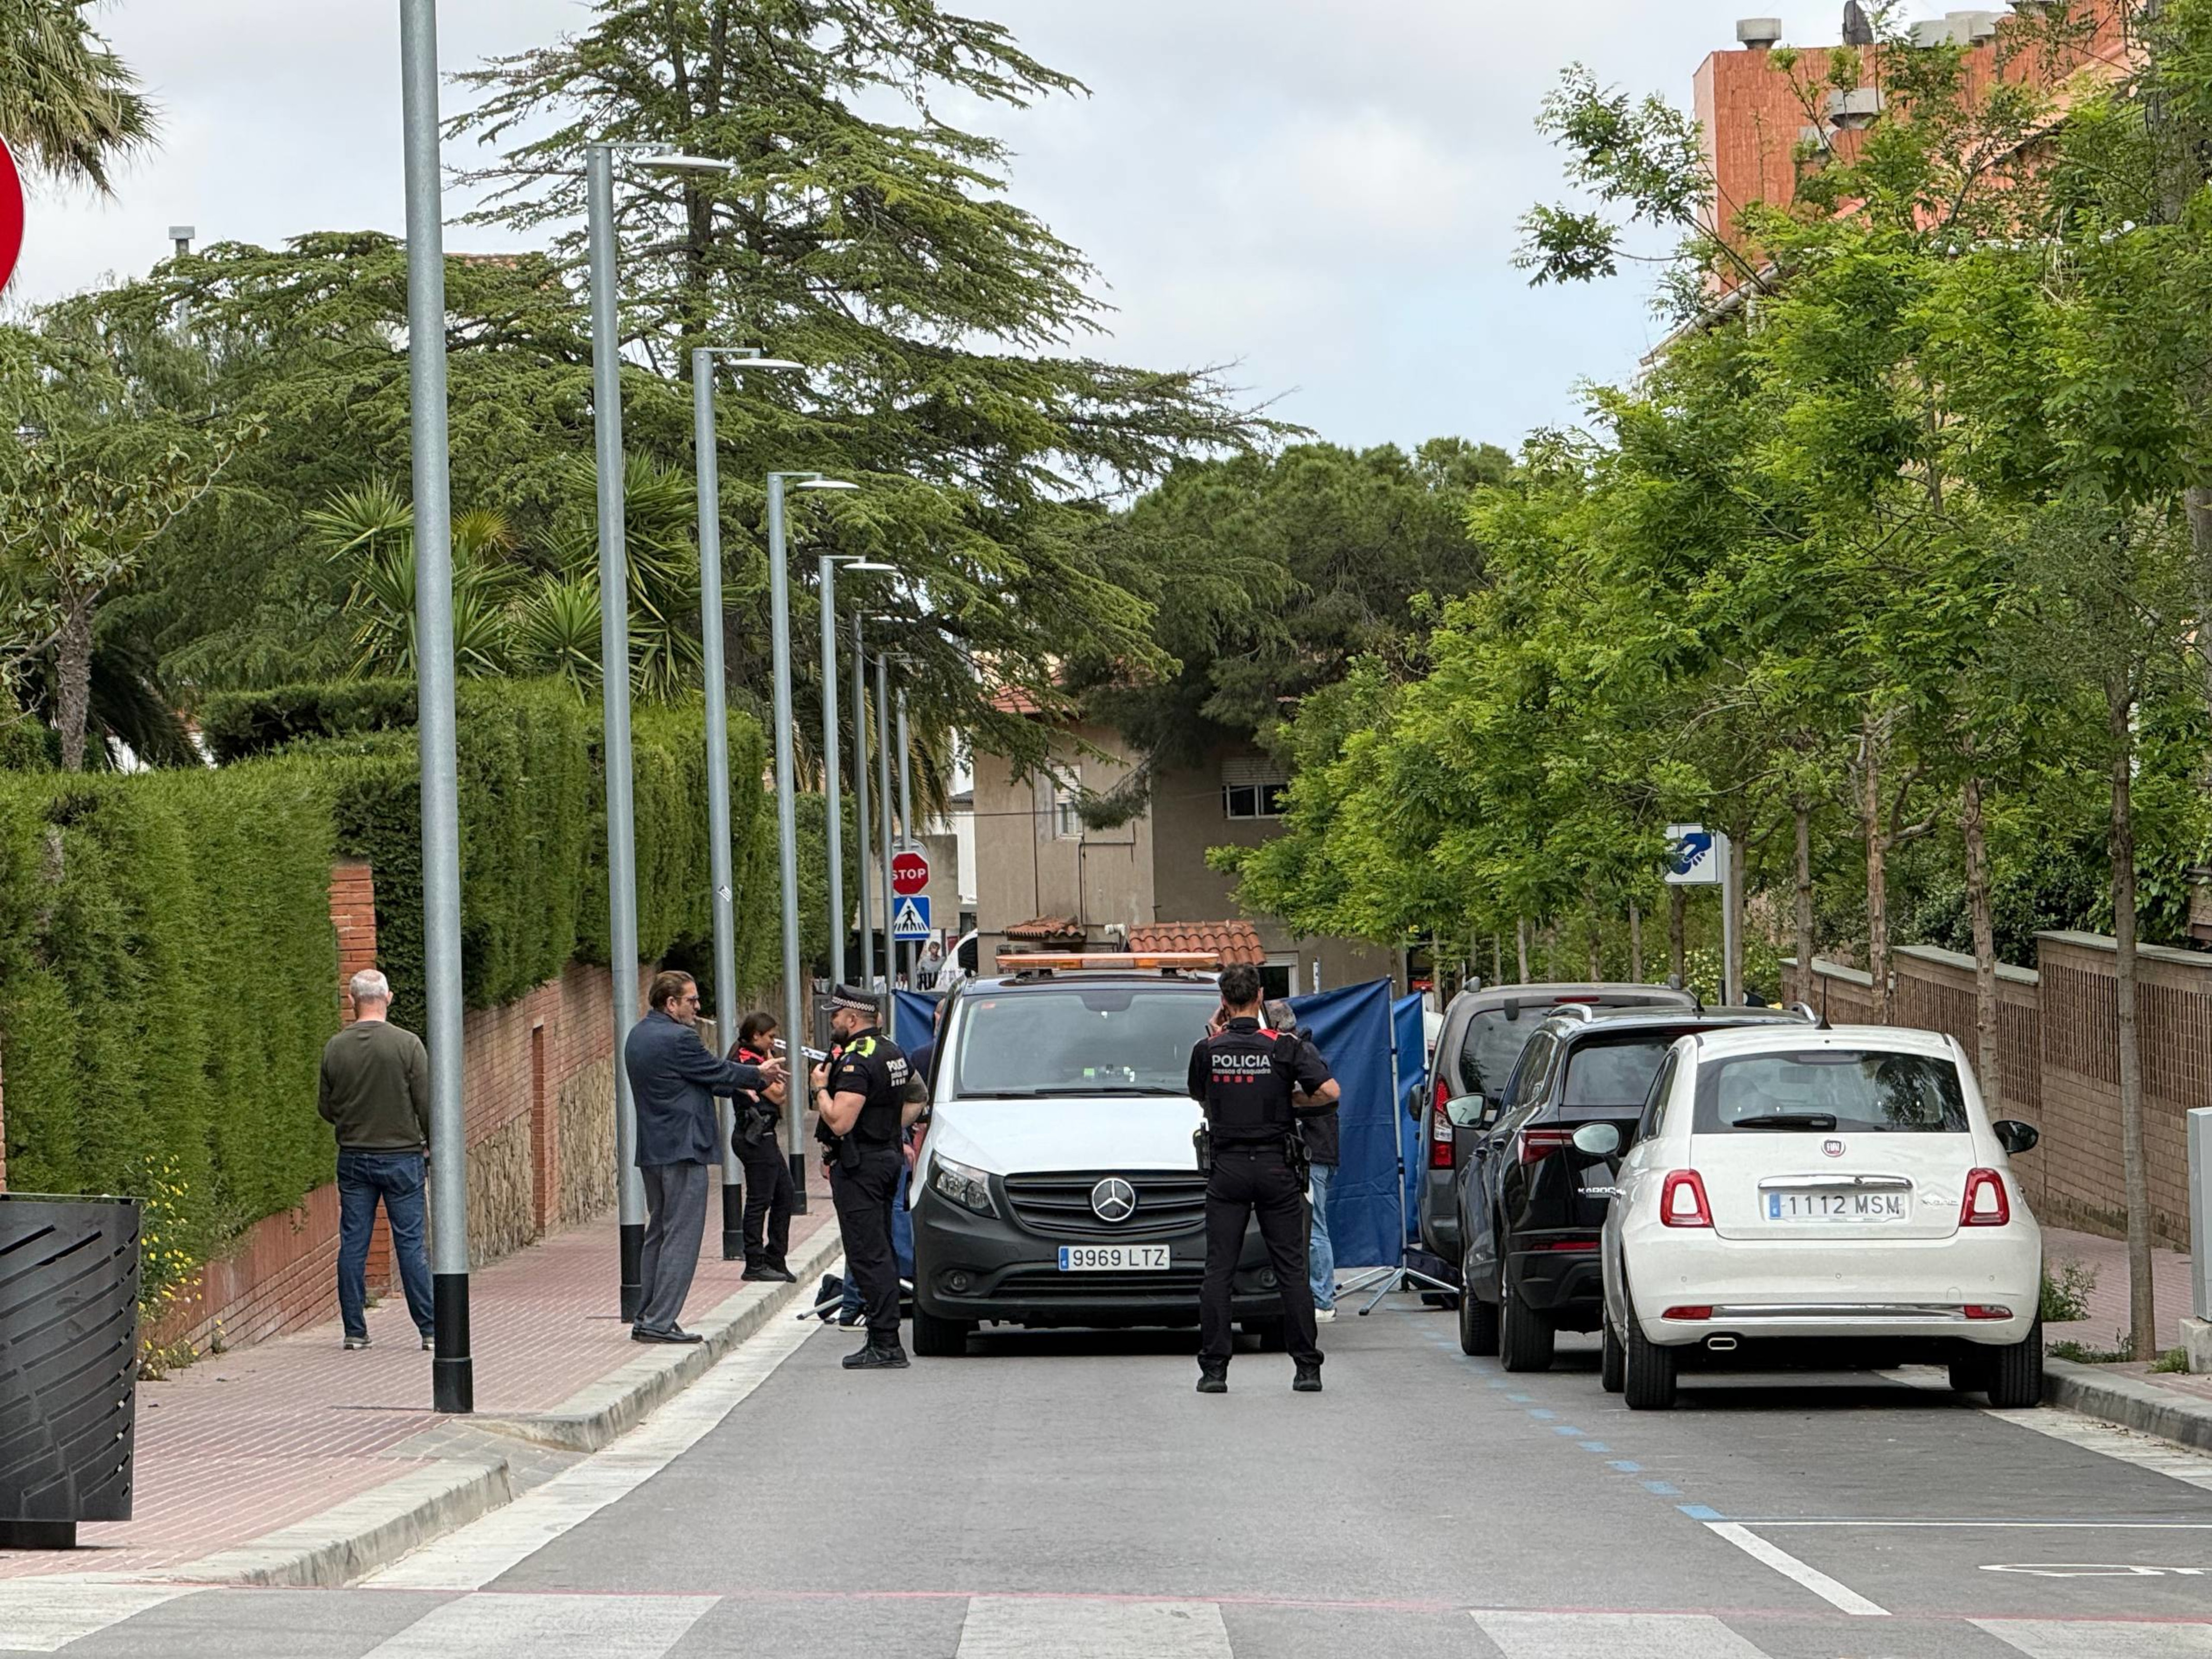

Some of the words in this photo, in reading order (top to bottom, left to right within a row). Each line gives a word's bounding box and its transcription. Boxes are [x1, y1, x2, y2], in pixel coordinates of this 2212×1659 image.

[892, 868, 926, 880] STOP
[1212, 1054, 1271, 1067] POLICIA
[1827, 1142, 1840, 1152] FIAT
[1789, 1195, 1846, 1215] 1112
[1855, 1195, 1900, 1214] MSM
[1073, 1249, 1121, 1267] 9969
[1129, 1249, 1165, 1266] LTZ
